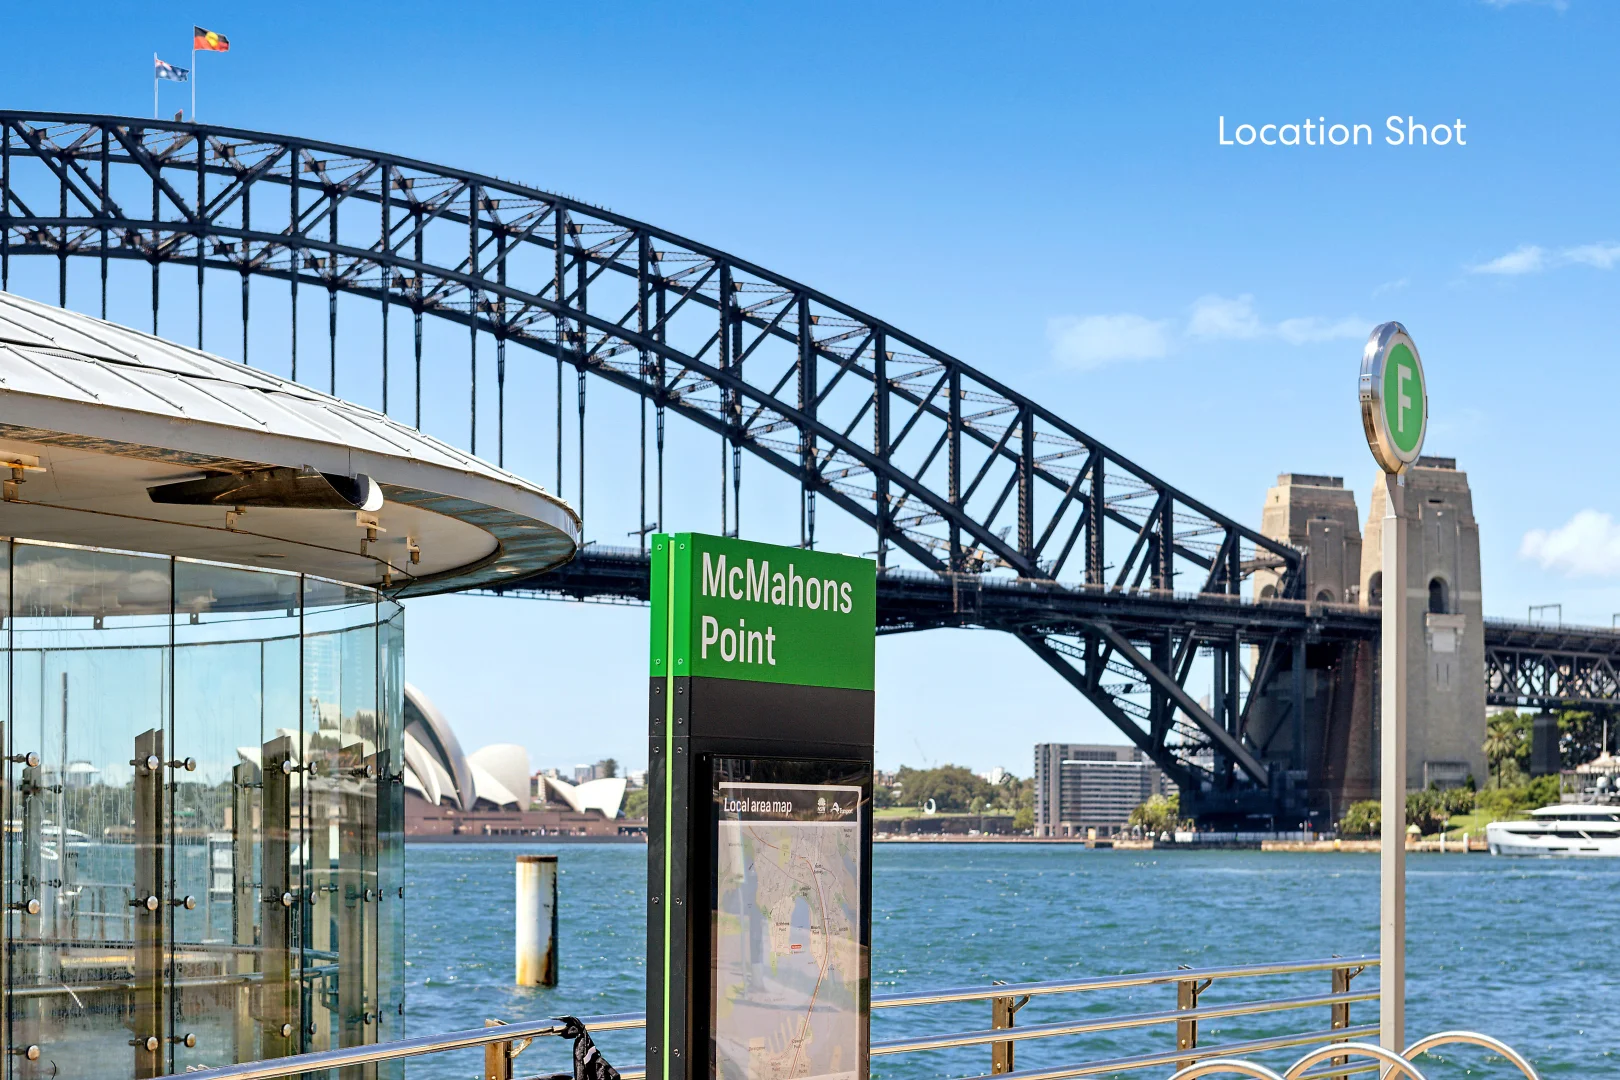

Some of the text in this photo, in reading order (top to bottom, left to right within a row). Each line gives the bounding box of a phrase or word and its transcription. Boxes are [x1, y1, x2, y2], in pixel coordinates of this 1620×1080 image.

[1398, 363, 1412, 433] F
[702, 552, 853, 614] McMahons
[701, 615, 776, 666] Point
[724, 797, 792, 818] Local area map
